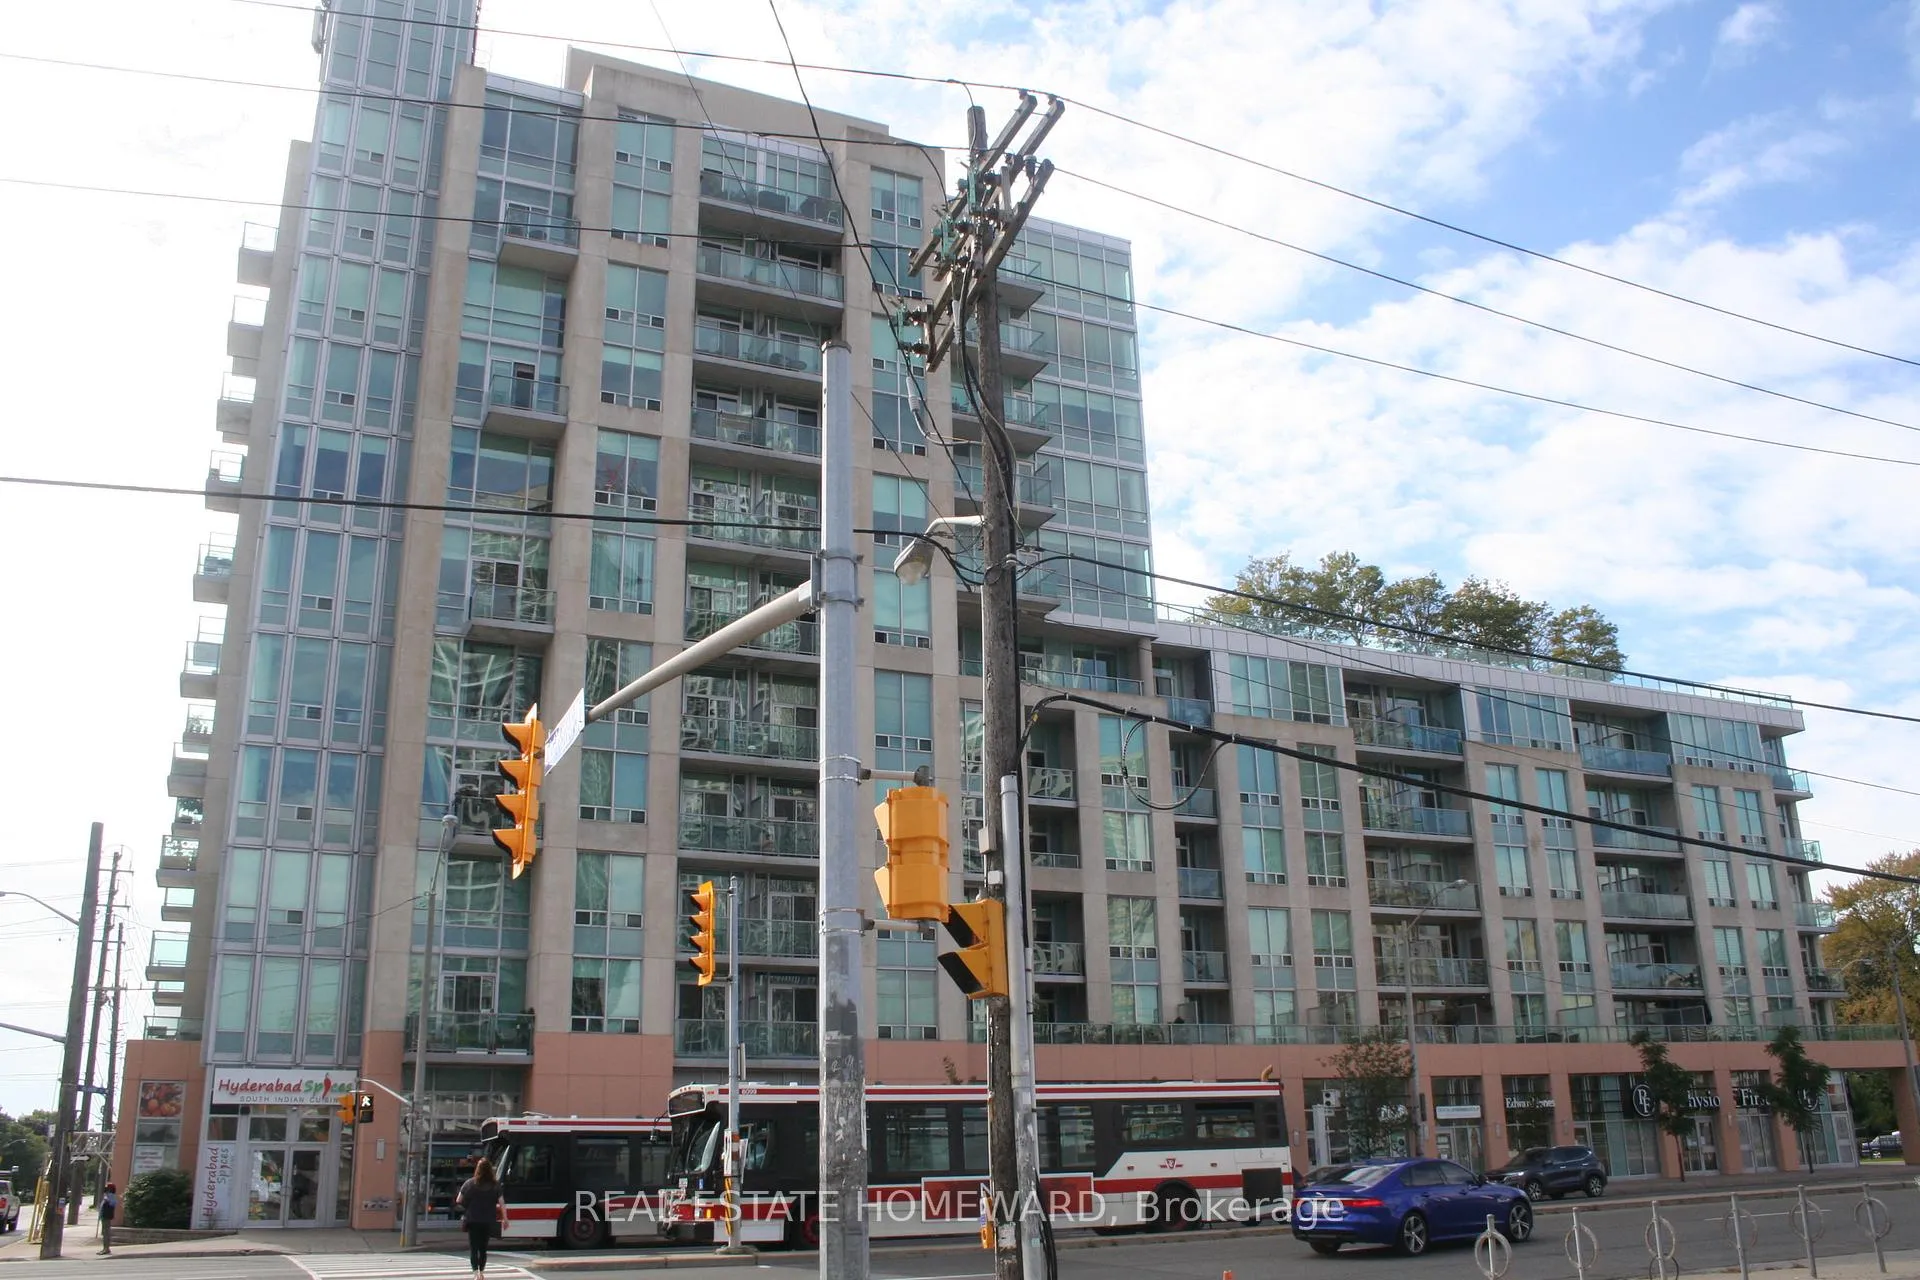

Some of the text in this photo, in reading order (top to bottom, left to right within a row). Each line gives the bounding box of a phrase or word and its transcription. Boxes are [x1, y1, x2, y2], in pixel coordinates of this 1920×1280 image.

[218, 1078, 302, 1096] Hyderabad
[240, 1095, 270, 1103] SOUTH
[203, 1147, 219, 1217] Hyderabad
